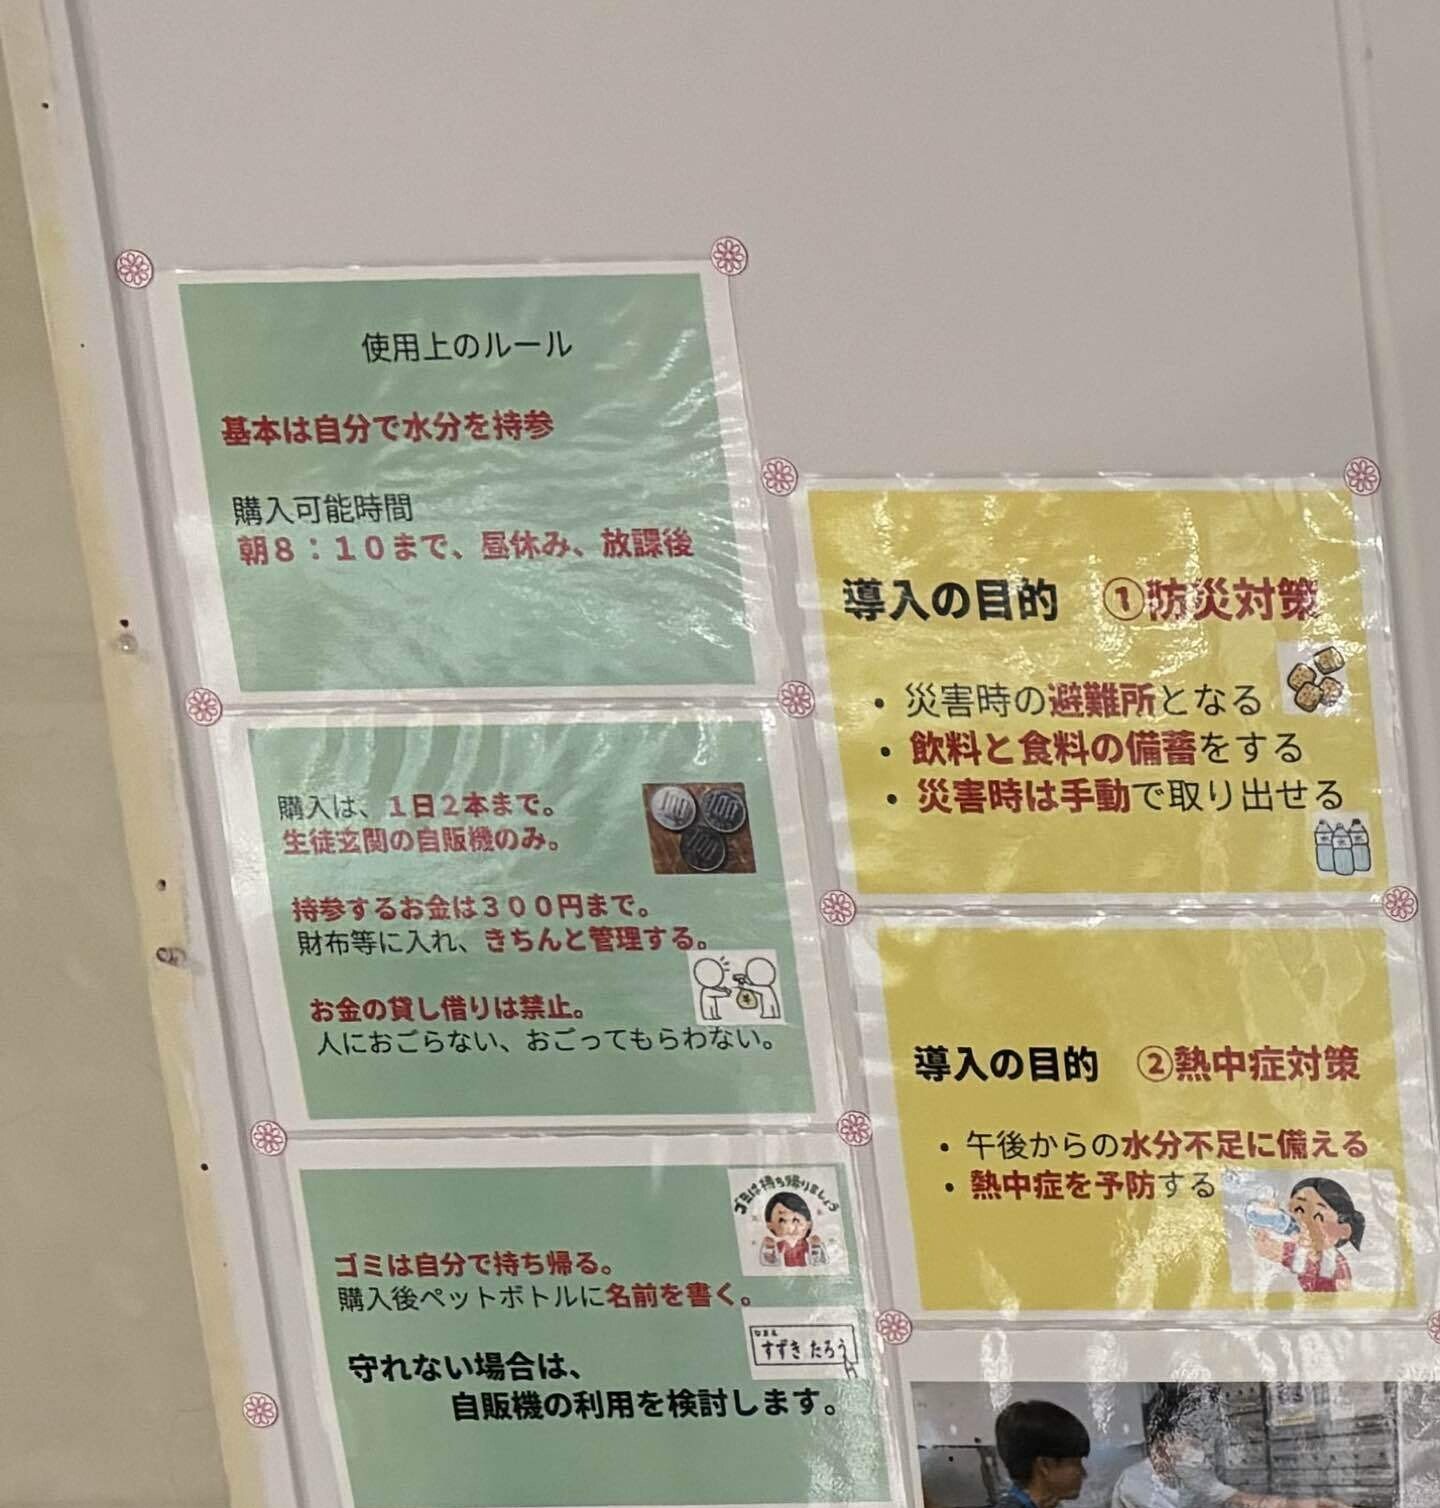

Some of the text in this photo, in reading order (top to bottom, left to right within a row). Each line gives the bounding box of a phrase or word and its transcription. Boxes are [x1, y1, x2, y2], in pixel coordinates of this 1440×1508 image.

[361, 330, 573, 363] 使用上のルール
[220, 410, 555, 447] 基本は自分で水分を持参
[233, 493, 413, 526] 購入可能時間
[843, 577, 1059, 623] 導入の目的
[283, 825, 560, 856] 生徒玄関の自販機のみ。
[298, 926, 708, 957] 財布等に入れ、きちんと管理する。
[310, 994, 585, 1025] お金の貸し借りは禁止。
[317, 1027, 775, 1057] 人におごらない、おごってもらわない。
[913, 1044, 1099, 1084] 導入の目的
[335, 1250, 614, 1280] ゴミは自分で持ち帰る。
[338, 1281, 753, 1313] 購入後ペットボトルに名前を書く。
[348, 1352, 583, 1383] 守れない場合は、
[451, 1389, 839, 1421] 自販機の利用を検討します。
